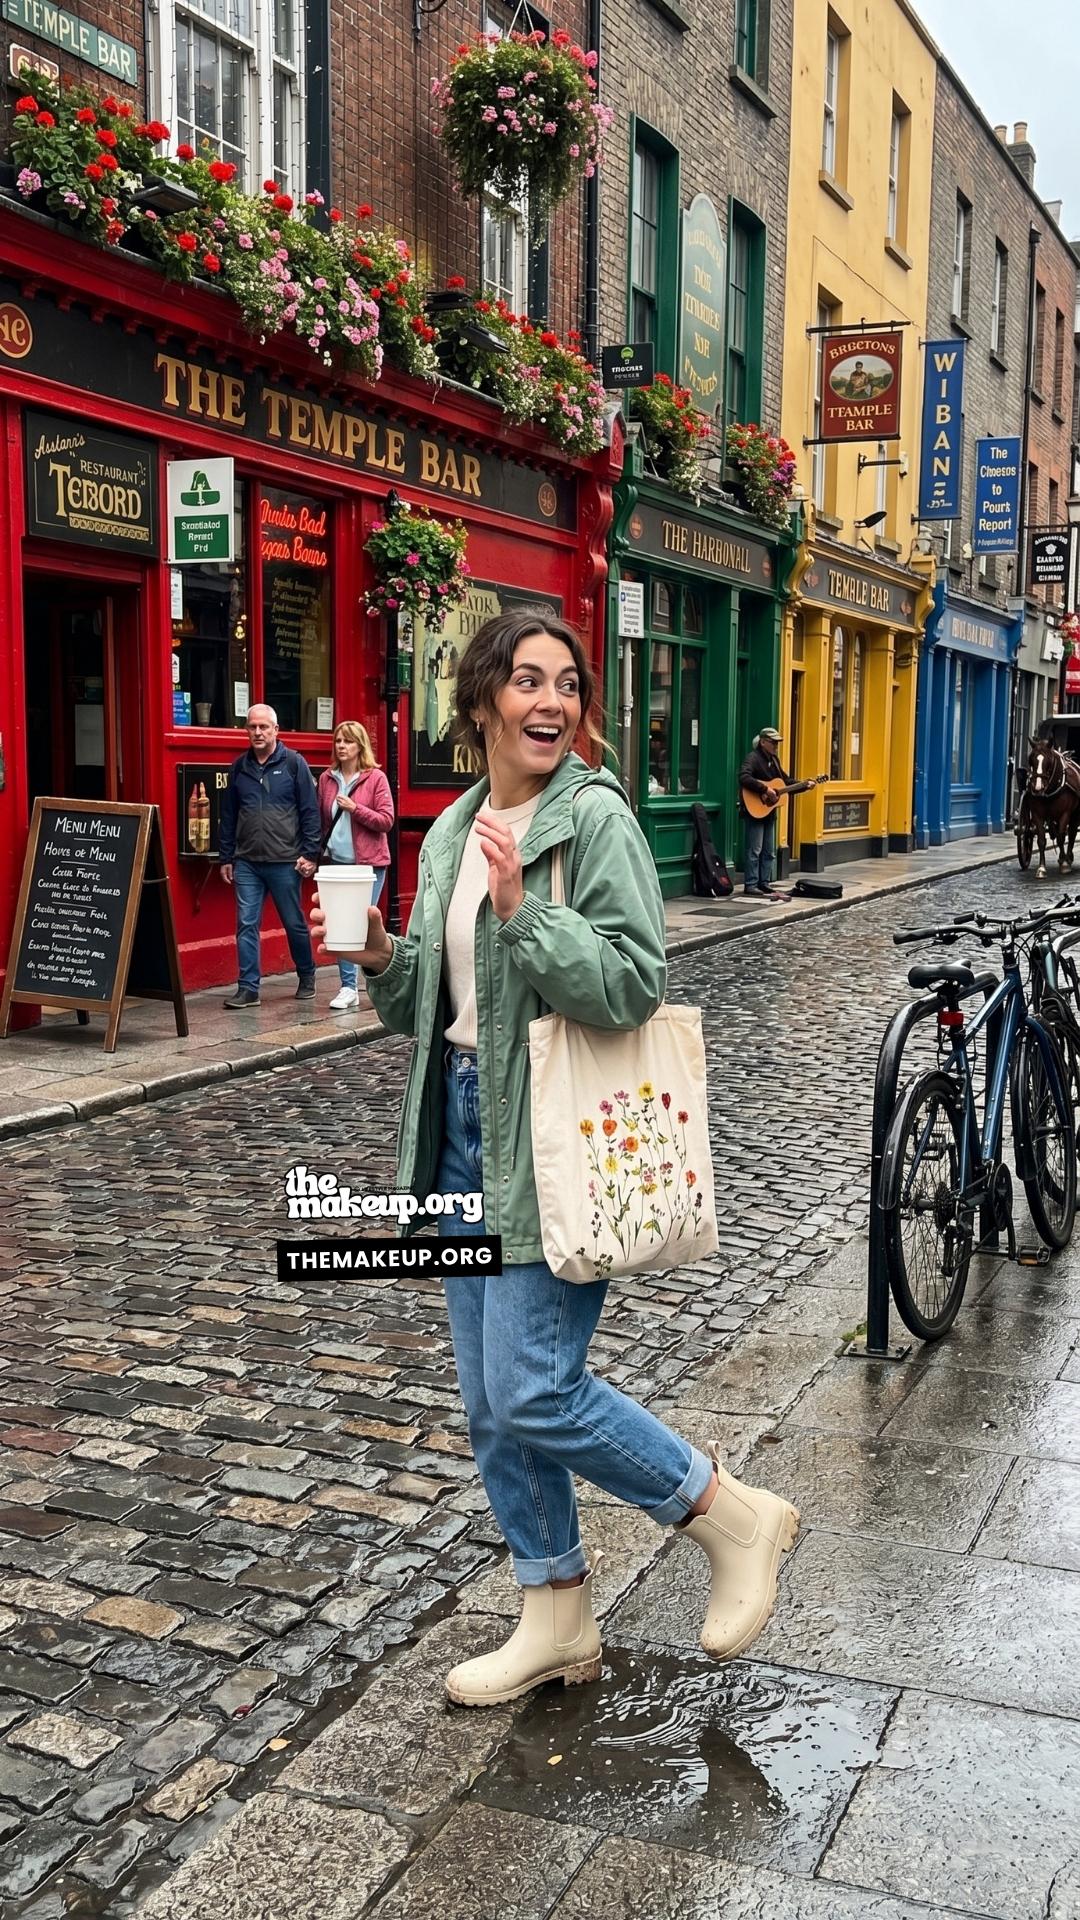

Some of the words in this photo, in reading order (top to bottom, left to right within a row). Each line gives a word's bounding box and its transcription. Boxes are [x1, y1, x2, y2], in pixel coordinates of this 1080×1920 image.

[24, 0, 90, 55] TEMPLE
[98, 36, 131, 77] BAR
[155, 353, 247, 428] THE
[262, 387, 406, 474] TEMPLE
[419, 439, 482, 498] BAR
[846, 419, 874, 431] BAR
[990, 447, 1008, 459] The
[80, 459, 139, 485] RESTAURANT
[992, 483, 1002, 496] to
[299, 506, 326, 536] Bad
[979, 518, 1011, 533] Report
[662, 520, 689, 554] THE
[870, 587, 890, 613] BAR
